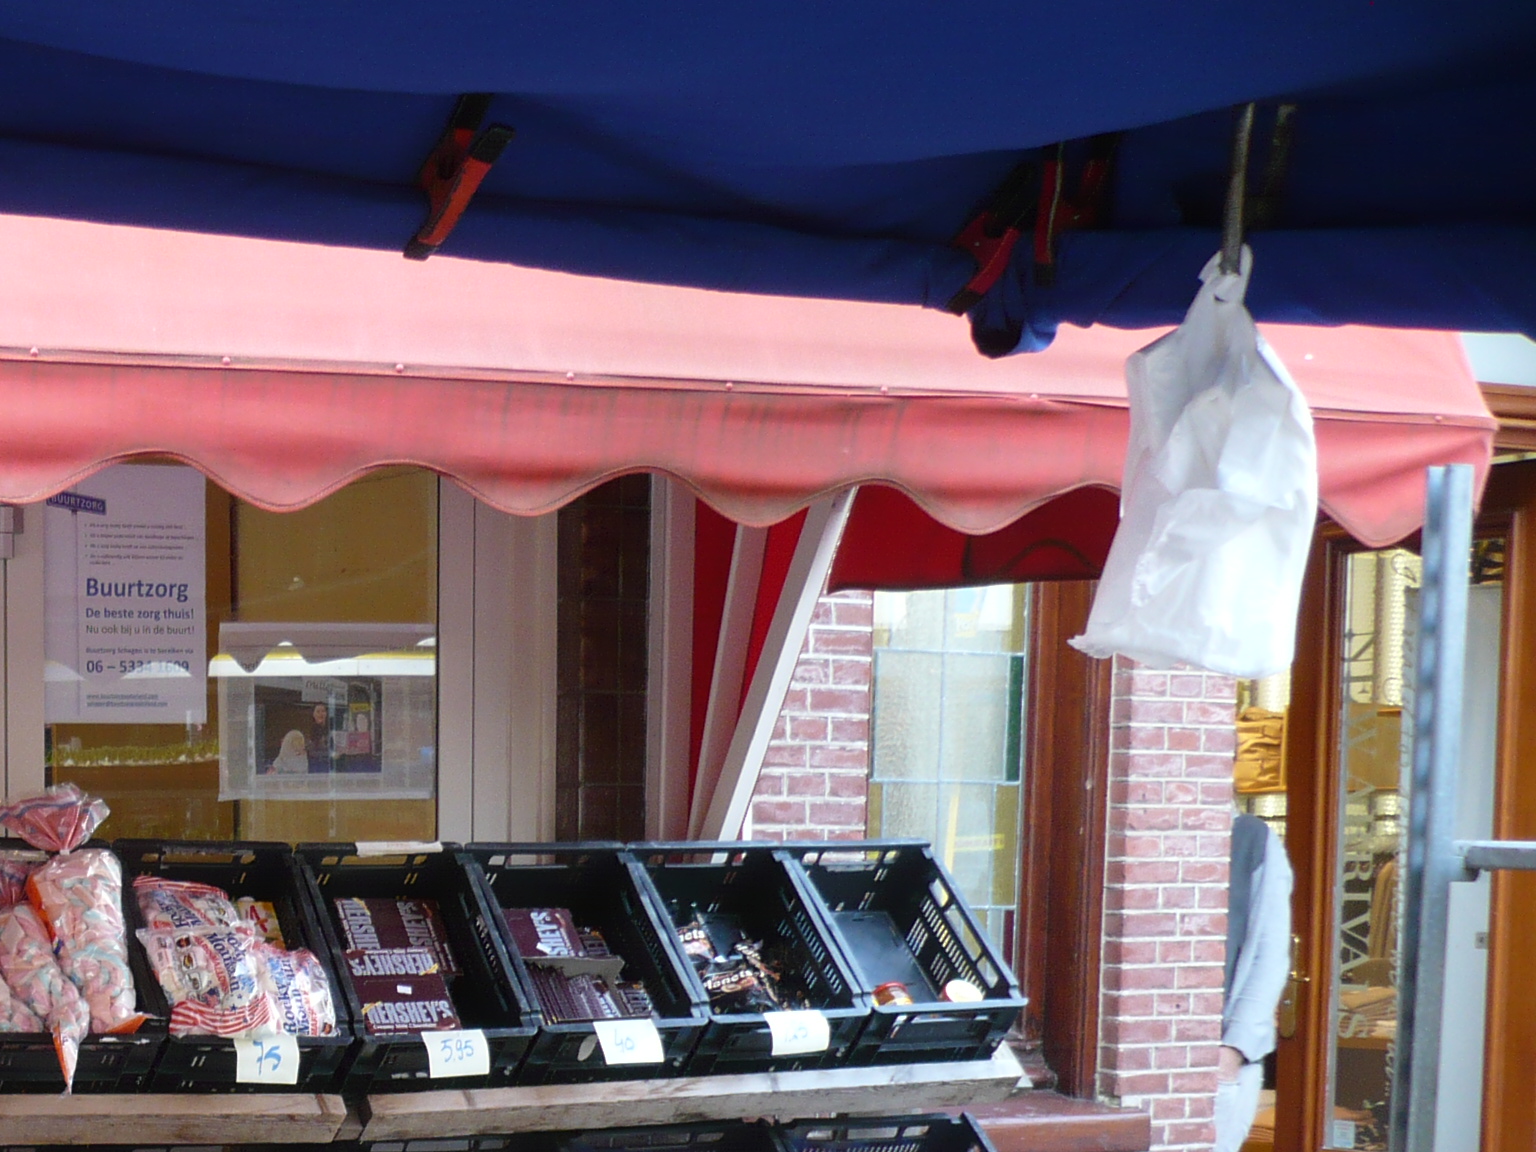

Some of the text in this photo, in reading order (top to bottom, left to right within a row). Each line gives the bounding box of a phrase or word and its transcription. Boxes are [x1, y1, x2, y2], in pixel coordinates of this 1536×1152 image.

[86, 577, 189, 603] Buurtzorg
[86, 607, 194, 621] De beste zorg thuis!
[86, 625, 99, 634] Nu
[101, 625, 119, 635] ook
[120, 625, 132, 636] bij
[142, 625, 151, 634] in
[153, 625, 165, 635] de
[167, 626, 195, 636] buurt!
[86, 660, 104, 673] 06
[364, 1000, 454, 1024] HERSHEY'S
[440, 1038, 475, 1063] 5.95
